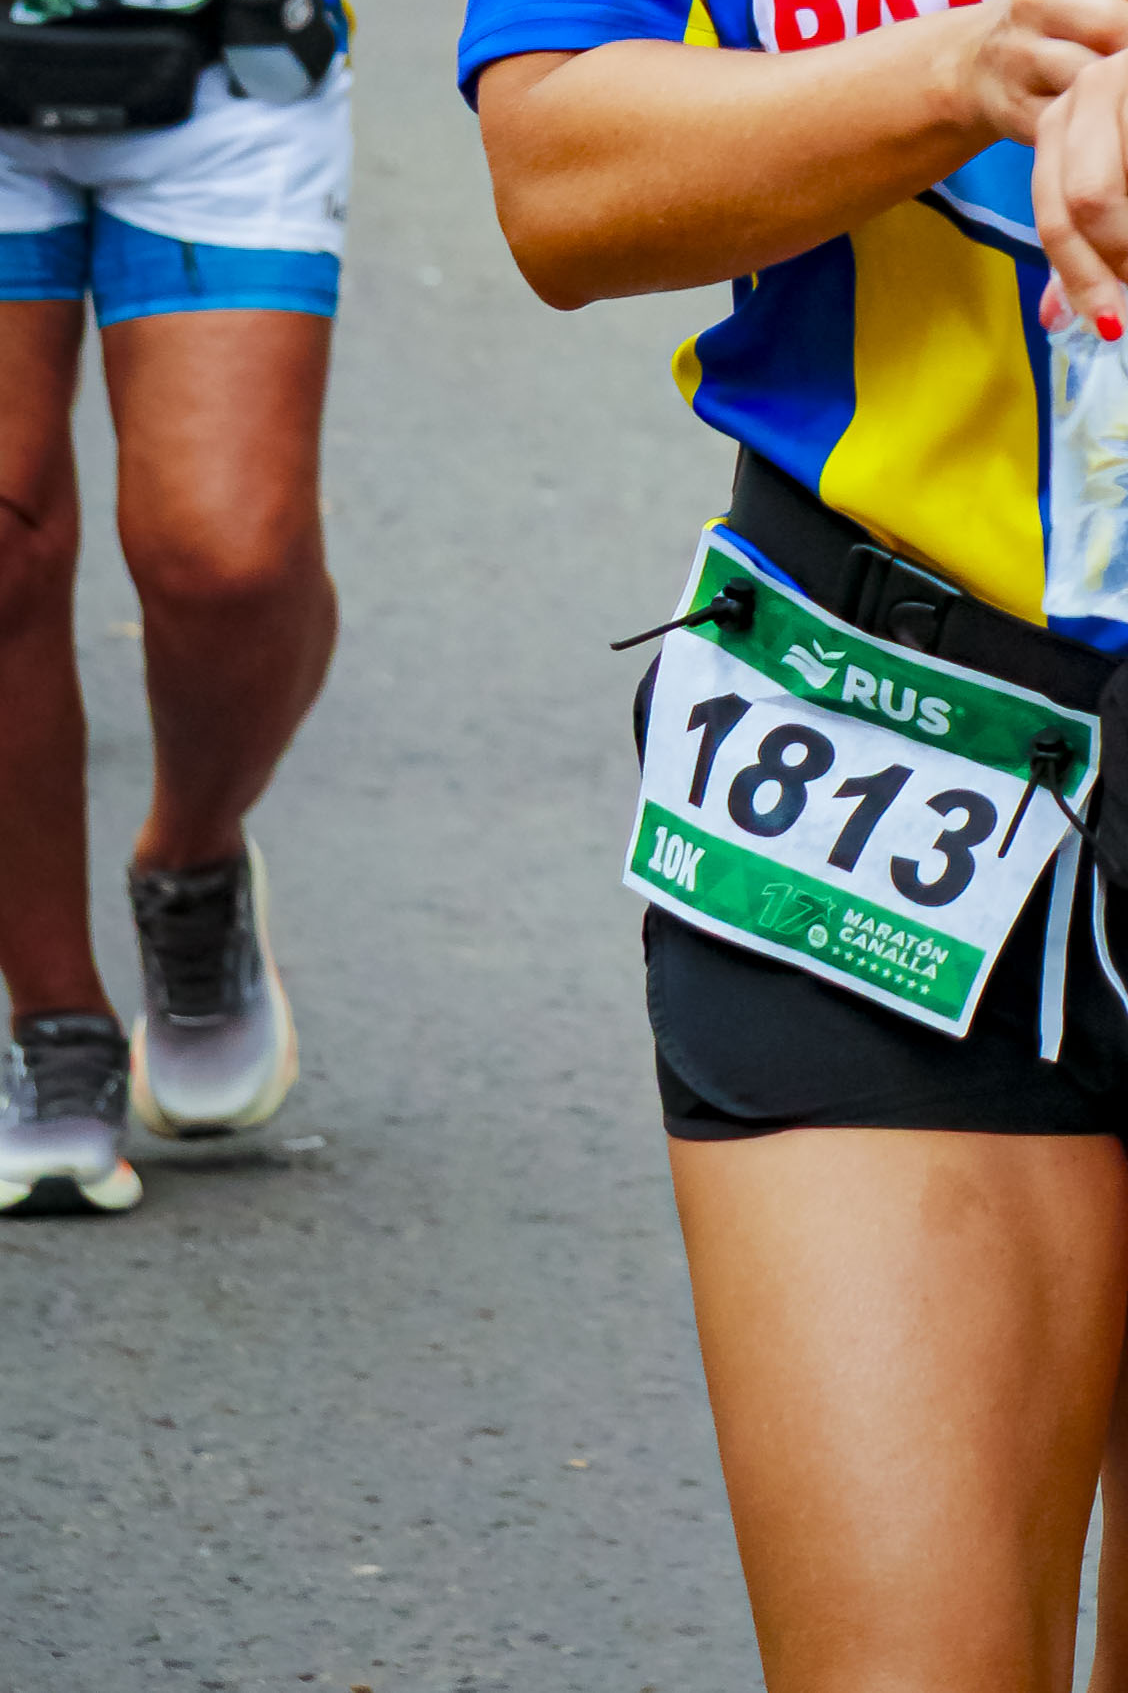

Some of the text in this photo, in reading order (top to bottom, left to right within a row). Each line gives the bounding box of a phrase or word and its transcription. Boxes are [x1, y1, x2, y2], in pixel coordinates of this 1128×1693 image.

[841, 664, 952, 736] RUS
[686, 692, 998, 907] 1813
[648, 826, 706, 892] 10K
[839, 926, 937, 980] CANALLA
[843, 908, 949, 965] MARATÓN
